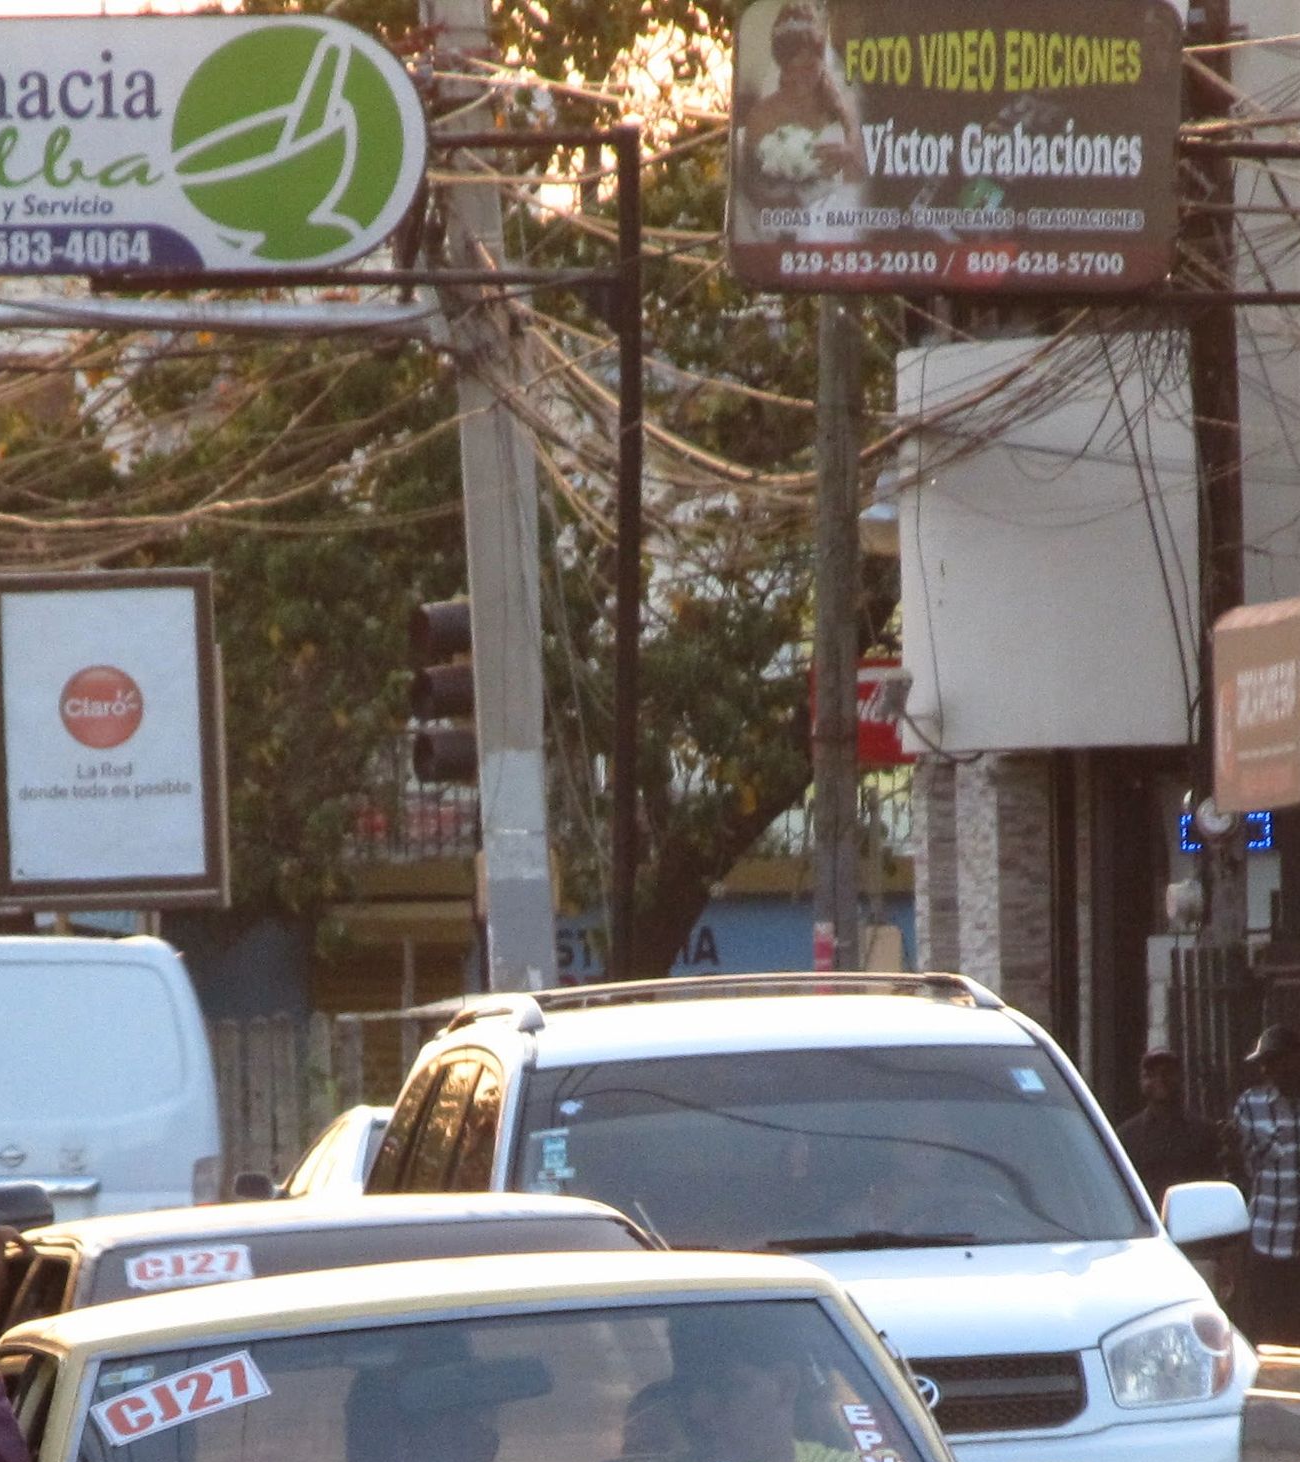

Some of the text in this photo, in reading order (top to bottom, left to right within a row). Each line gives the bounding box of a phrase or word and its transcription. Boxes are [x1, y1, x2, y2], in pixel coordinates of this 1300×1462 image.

[845, 29, 1142, 92] FOTO VIDEO EDICIONES
[960, 118, 1143, 177] Grabaciones
[1, 201, 17, 221] y
[23, 195, 114, 217] Servicio
[780, 251, 937, 275] 829-583-2010
